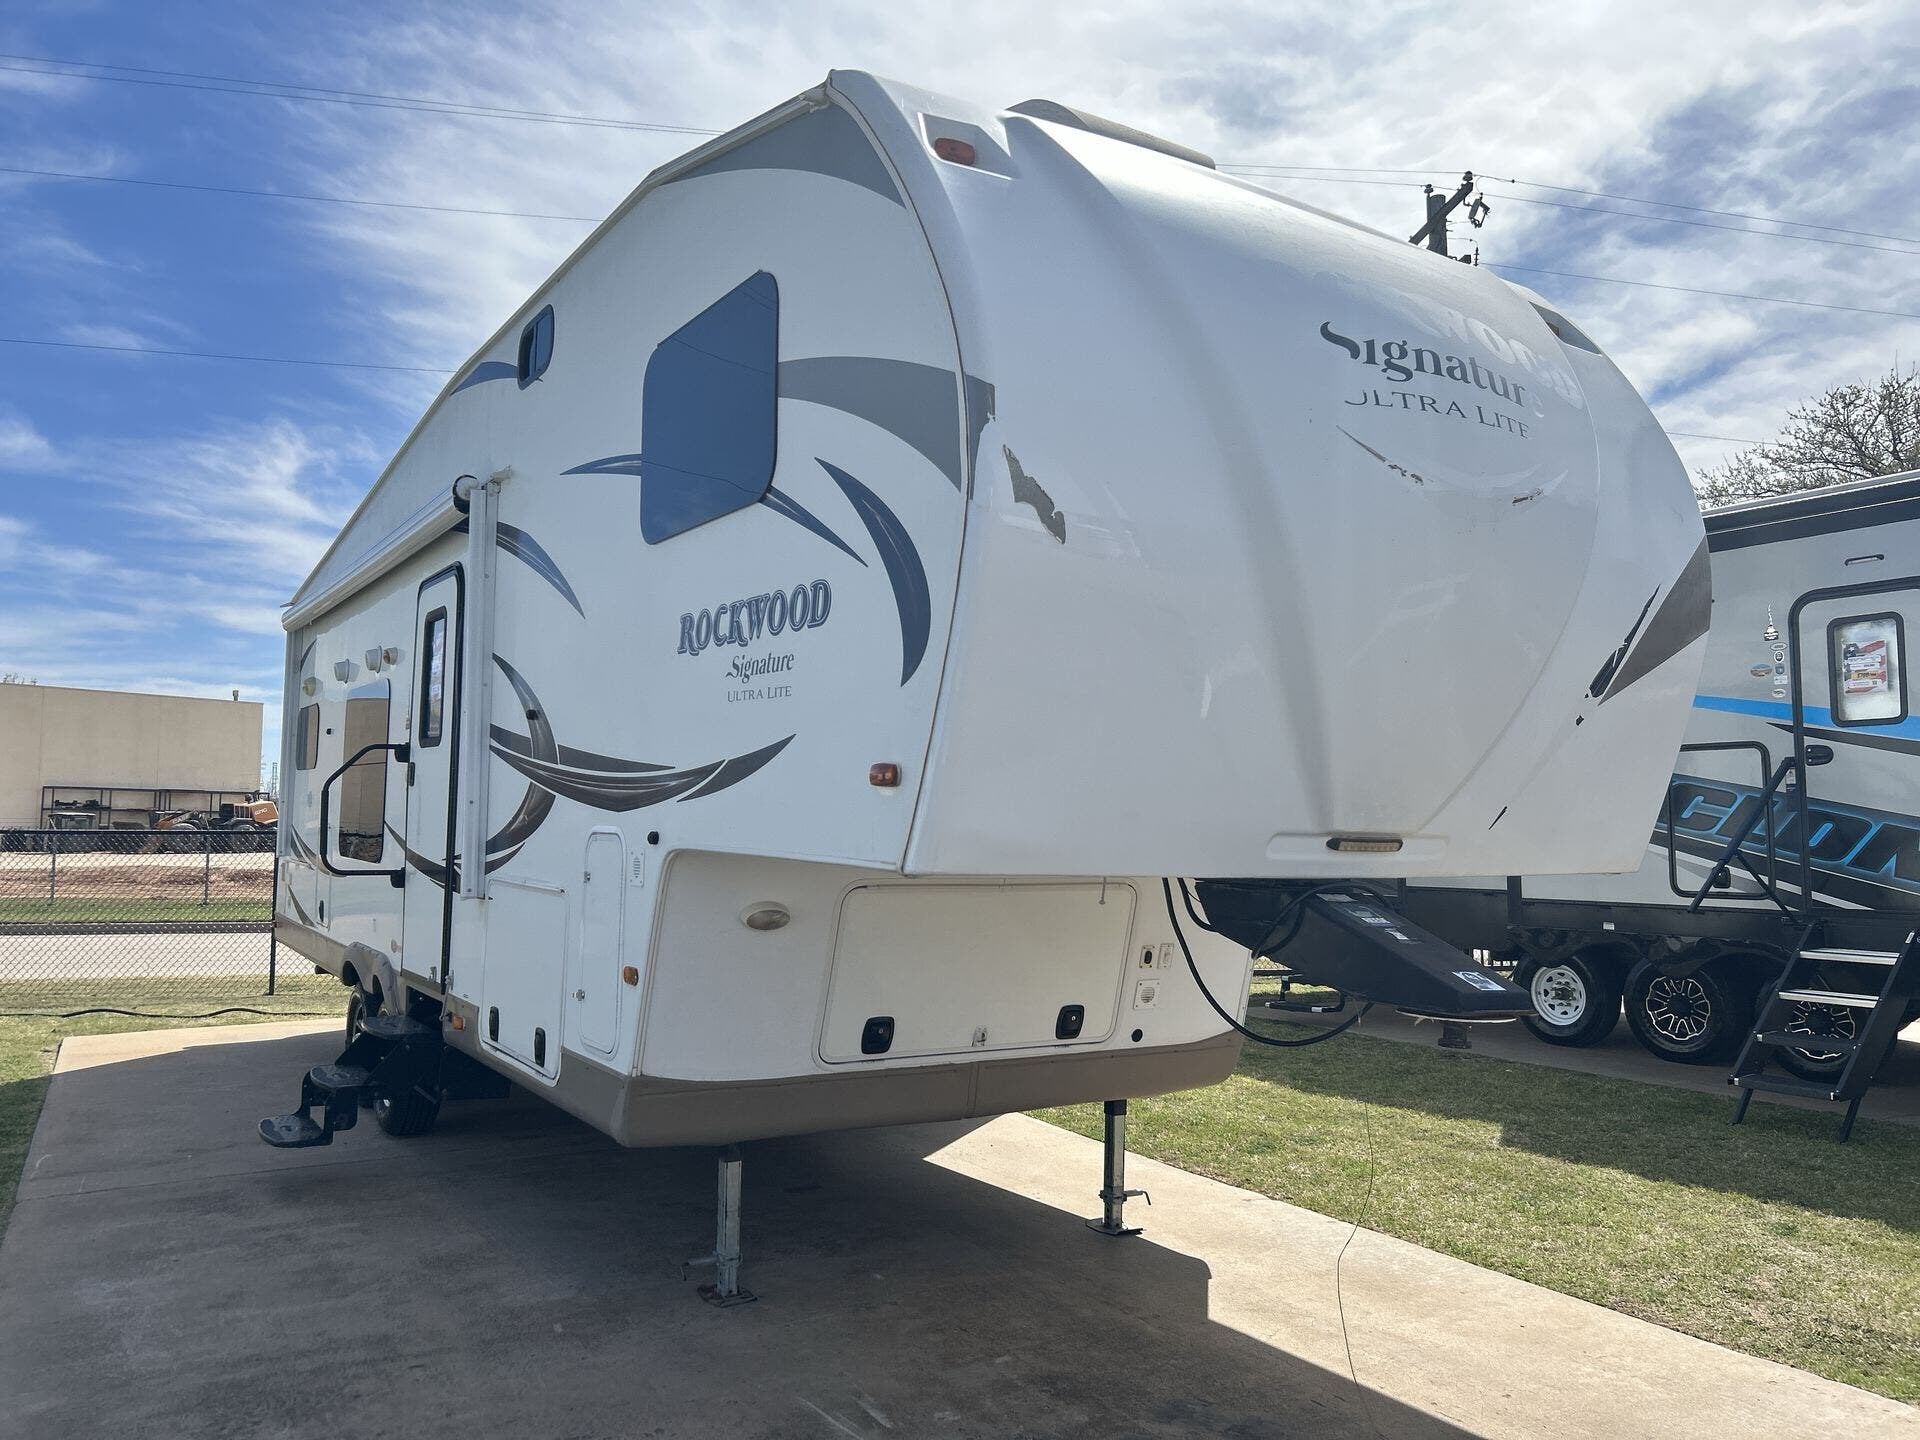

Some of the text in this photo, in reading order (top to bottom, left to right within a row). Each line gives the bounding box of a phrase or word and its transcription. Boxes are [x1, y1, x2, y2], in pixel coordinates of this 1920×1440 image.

[677, 578, 832, 656] ROCKWOOD
[725, 651, 795, 684] Signature
[727, 685, 792, 703] ULTRA LITE
